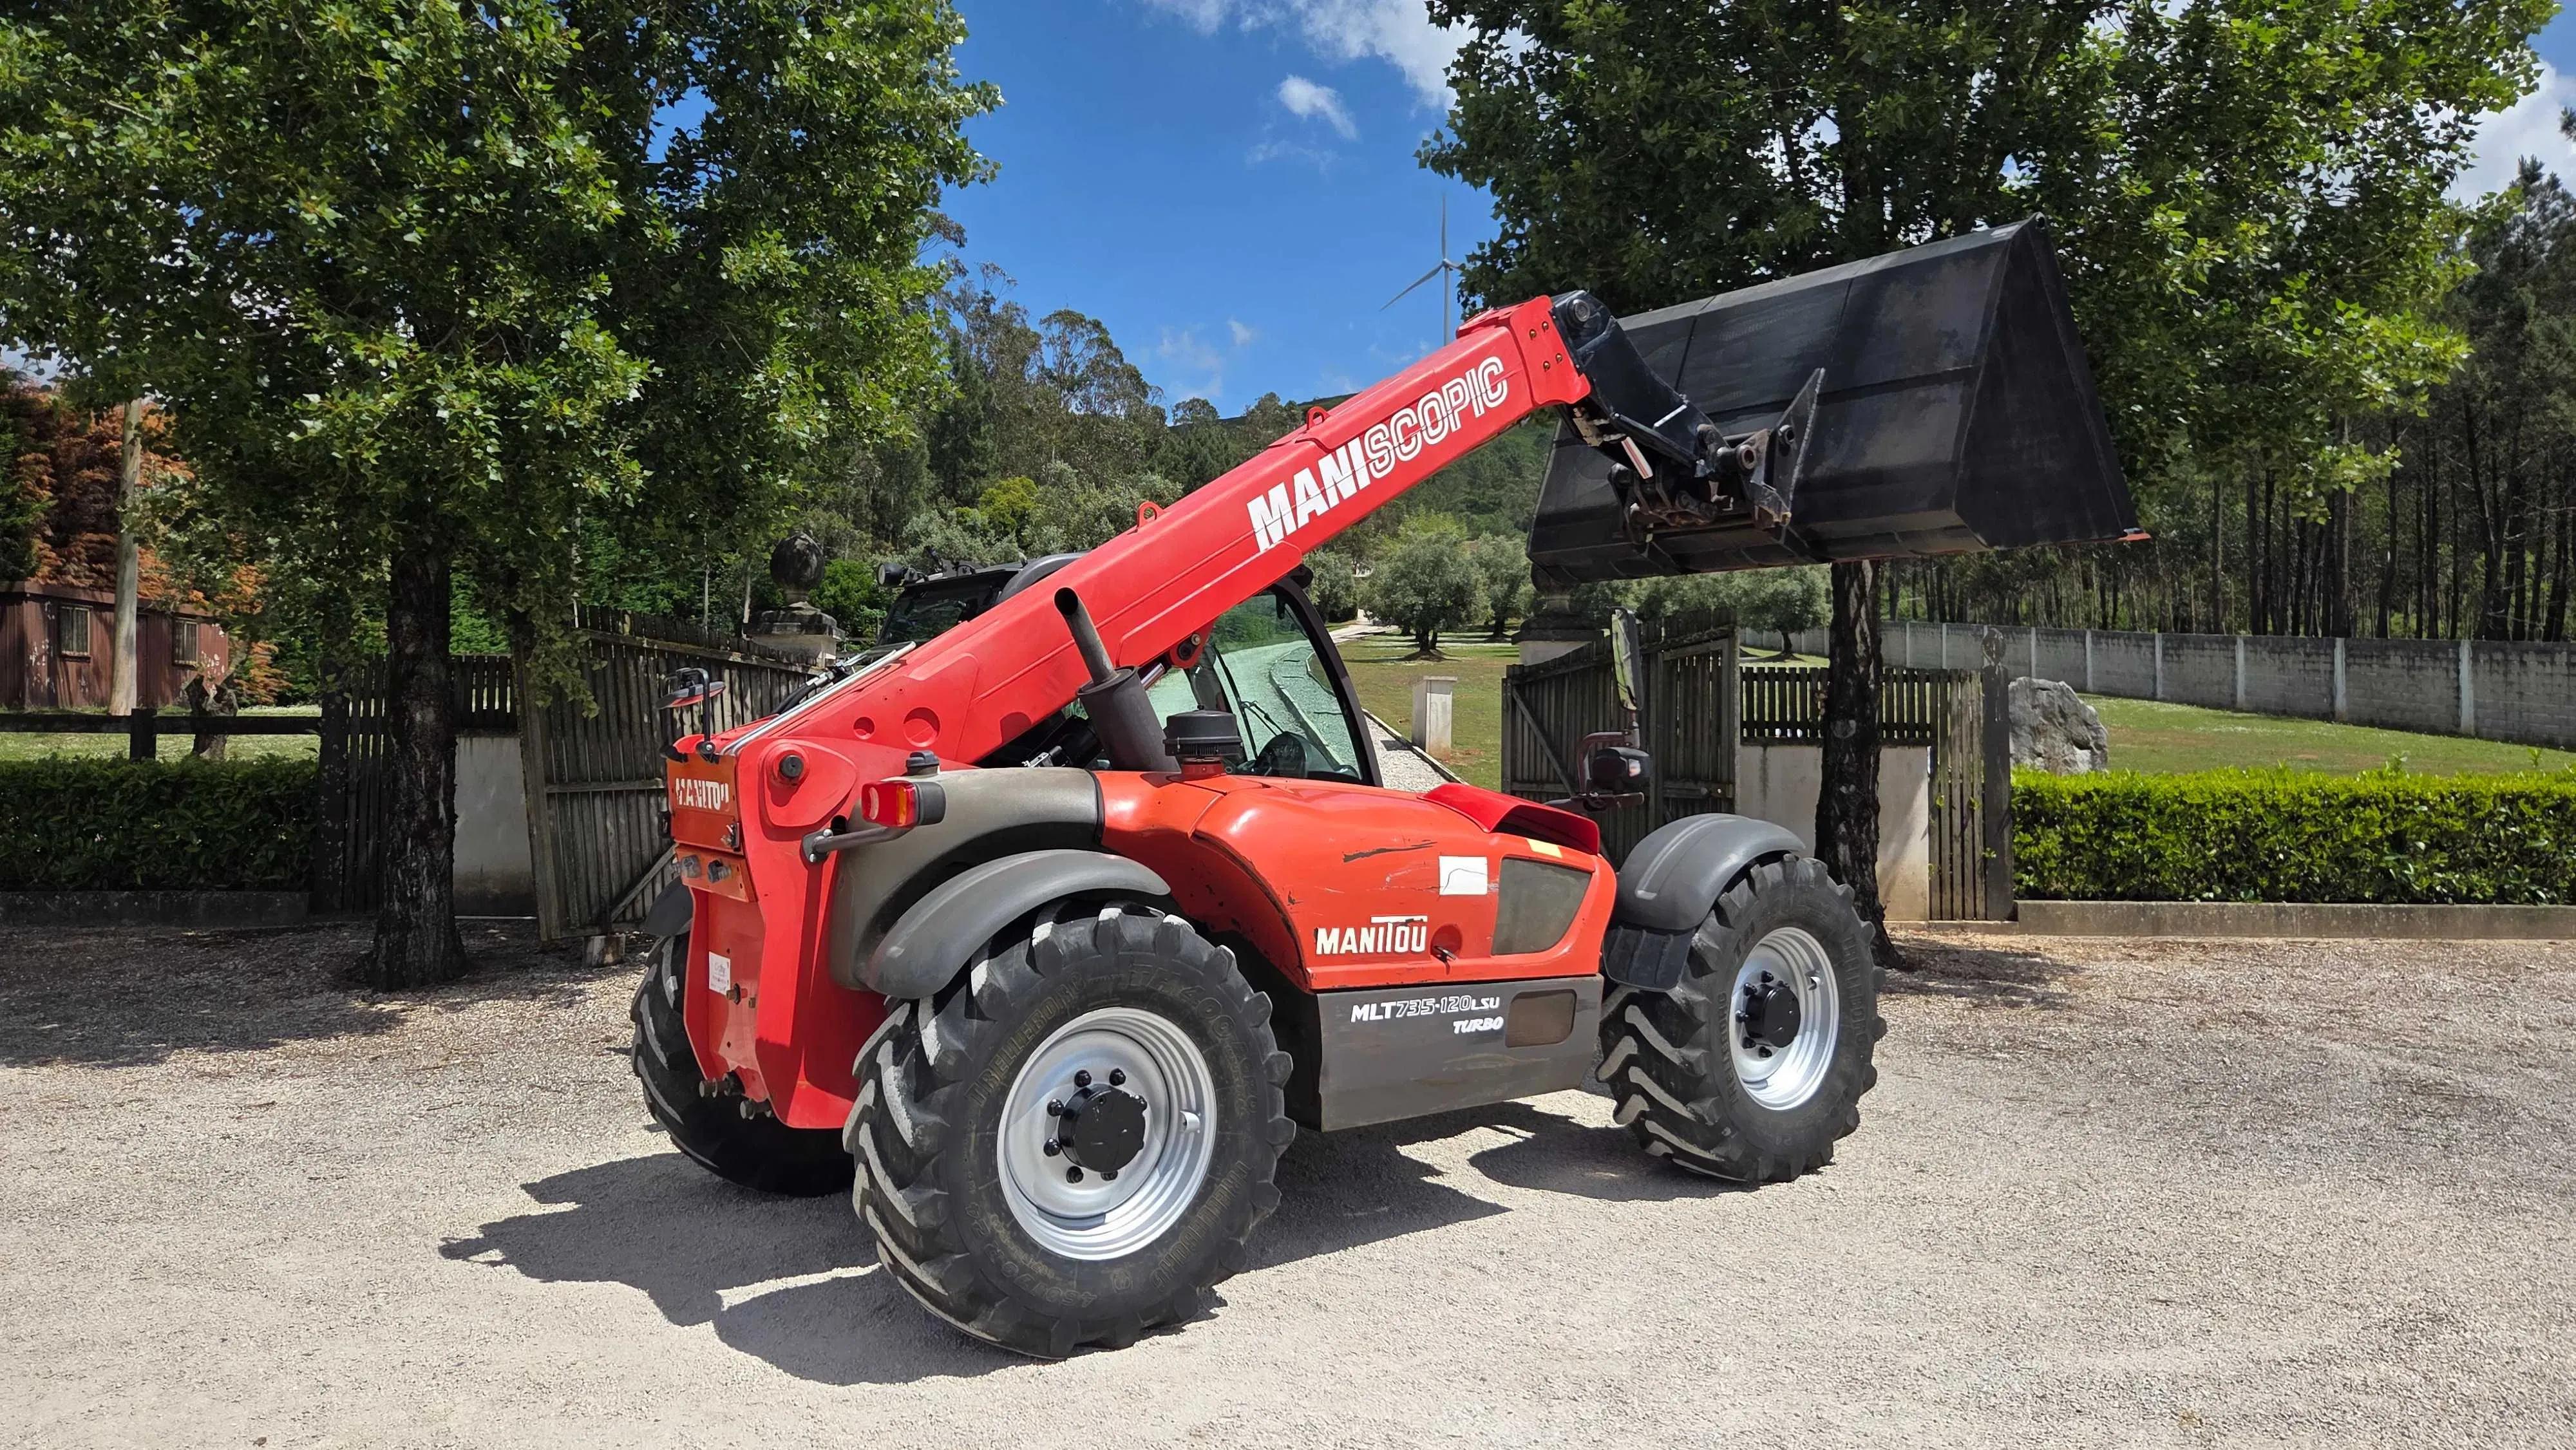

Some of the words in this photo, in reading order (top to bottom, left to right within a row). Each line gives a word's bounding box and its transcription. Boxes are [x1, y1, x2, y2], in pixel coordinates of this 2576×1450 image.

[1246, 356, 1508, 552] MANISCOPIC
[1316, 915, 1428, 954] MANITOU
[963, 971, 1084, 1107] TRELLEBORG
[1453, 1016, 1504, 1033] TURBO
